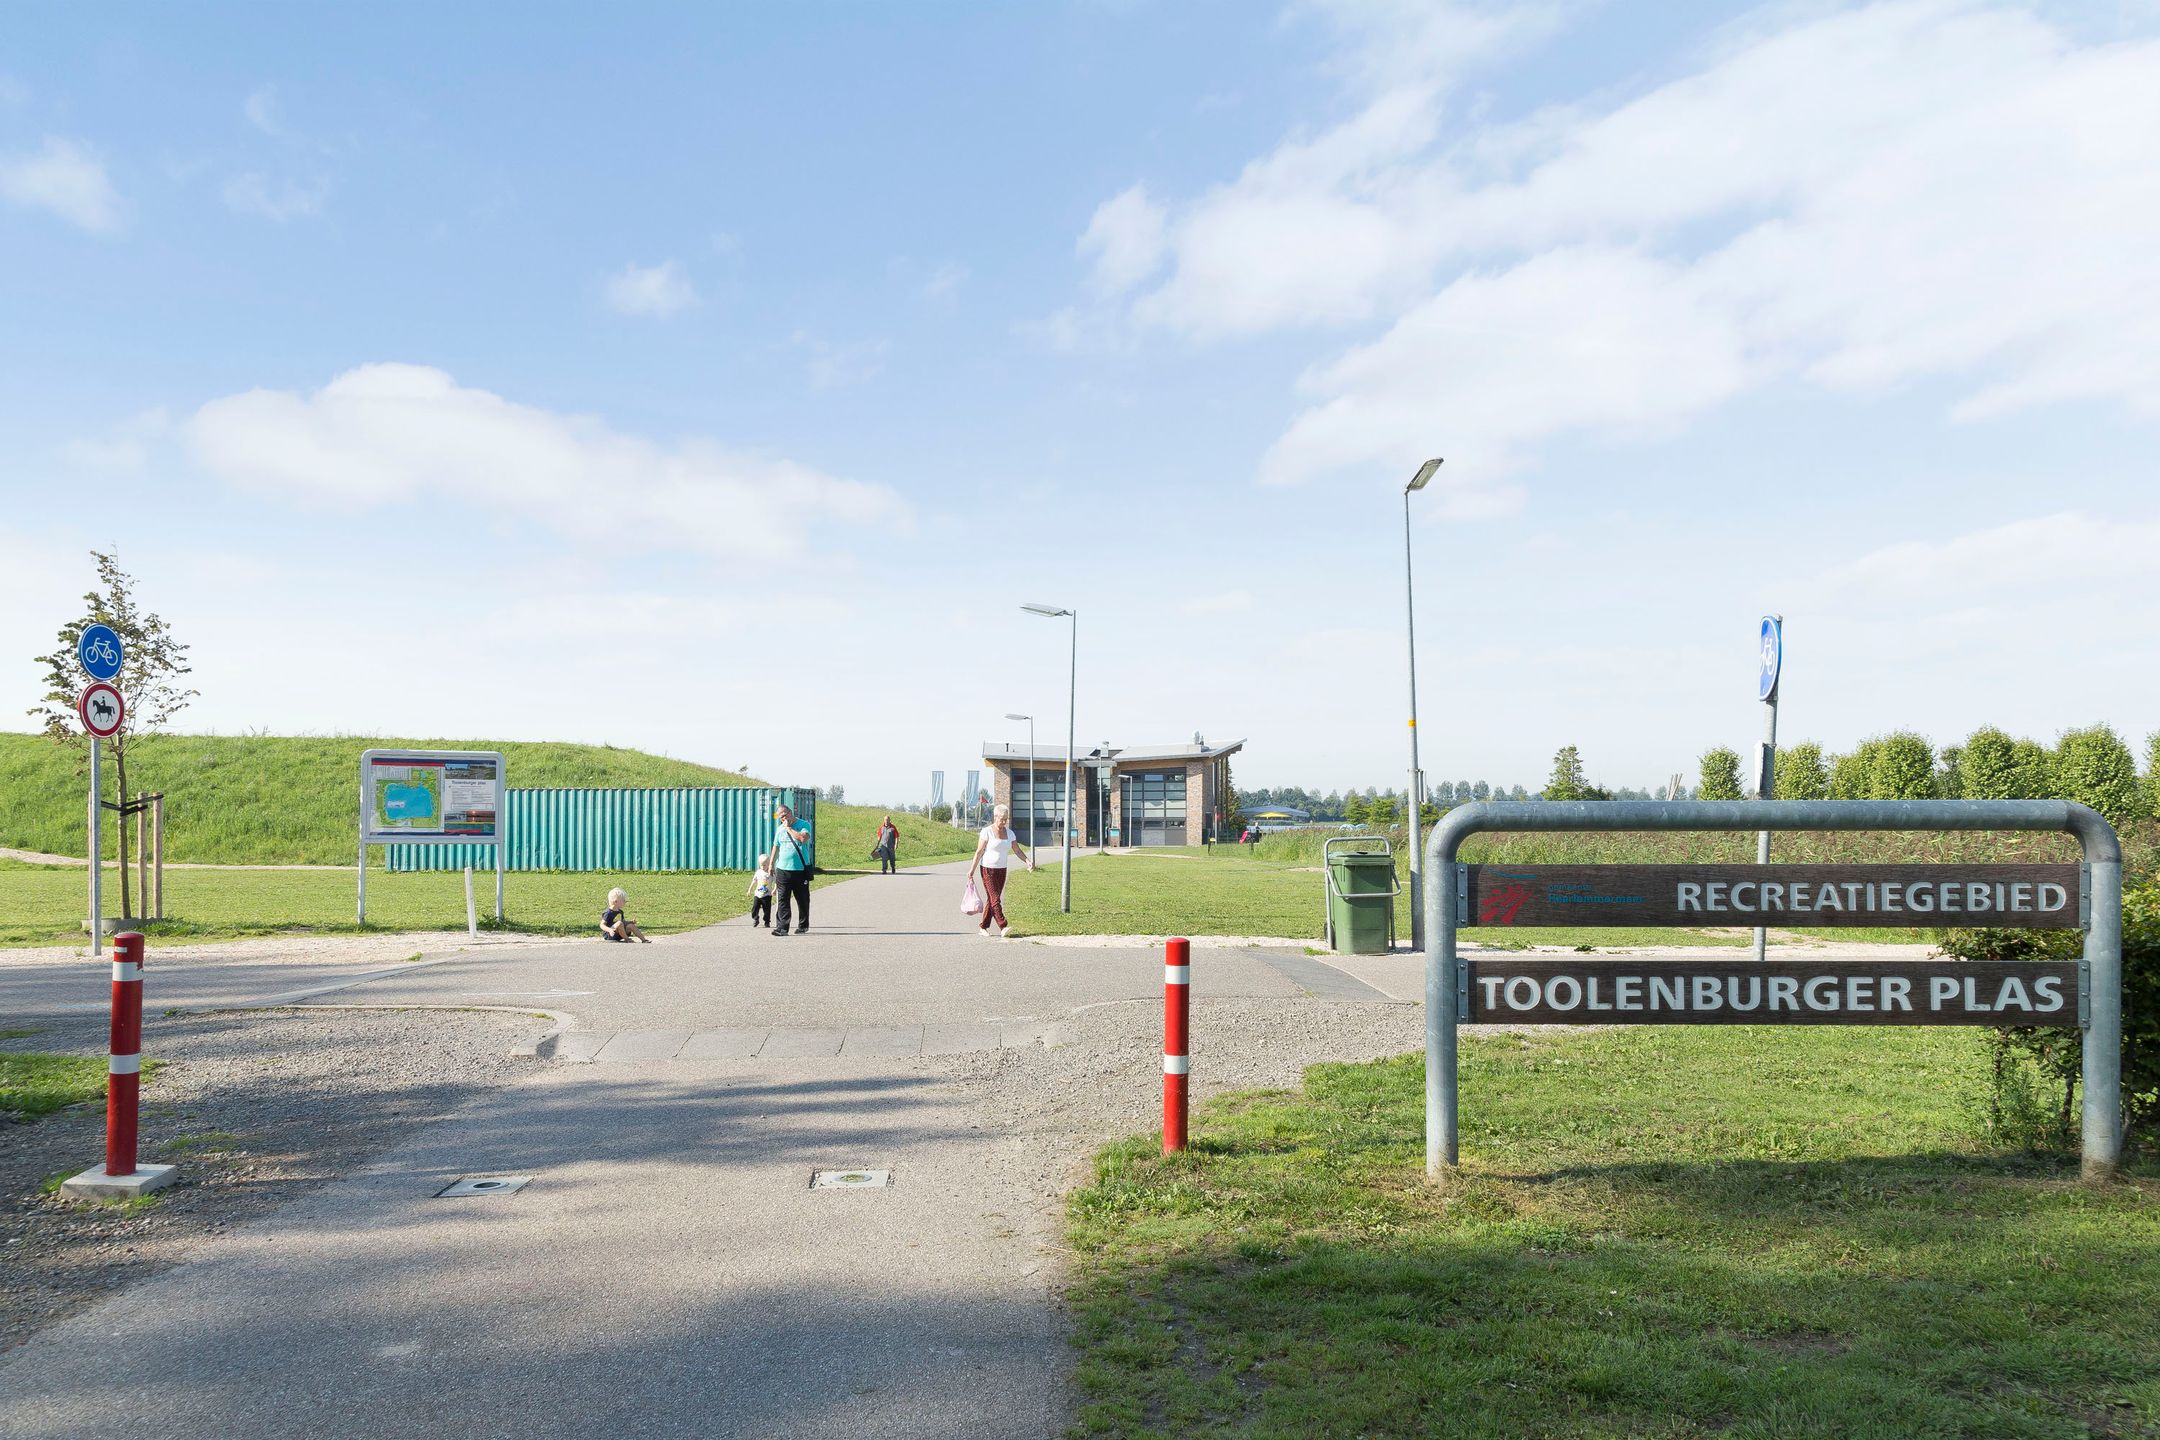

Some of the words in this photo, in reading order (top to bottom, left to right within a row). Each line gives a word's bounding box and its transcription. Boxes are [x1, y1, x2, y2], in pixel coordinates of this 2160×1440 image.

[1677, 882, 2066, 912] RECREATIEGEBIED
[1477, 976, 1913, 1011] TOOLENBURGER
[1930, 976, 2064, 1011] PLAS
